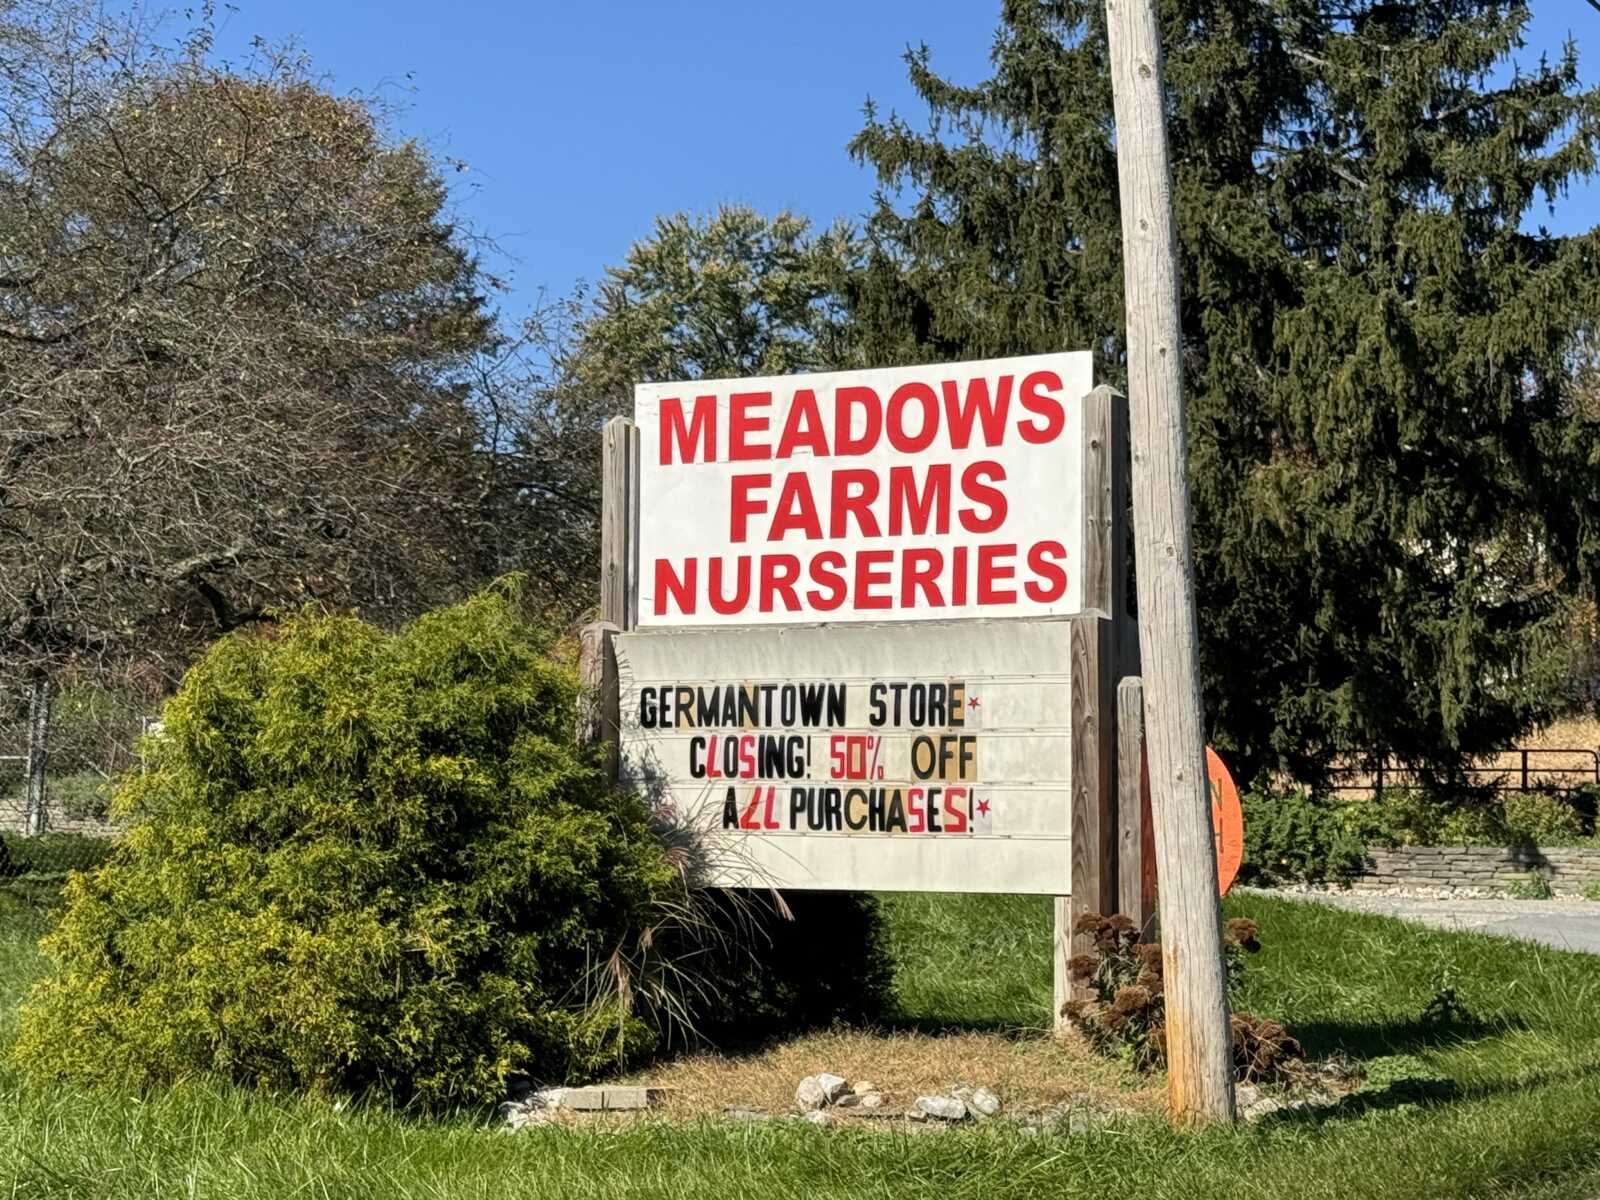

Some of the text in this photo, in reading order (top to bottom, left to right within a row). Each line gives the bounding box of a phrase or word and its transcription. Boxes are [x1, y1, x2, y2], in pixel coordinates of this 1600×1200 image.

[659, 371, 1066, 465] MEADOWS
[730, 460, 1008, 543] FARMS
[654, 540, 1068, 615] NURSERIES
[640, 682, 965, 729] GERMANTOWN STORE
[690, 735, 977, 780] CLOSING! 50% OFF
[790, 787, 974, 833] PURCHASES!
